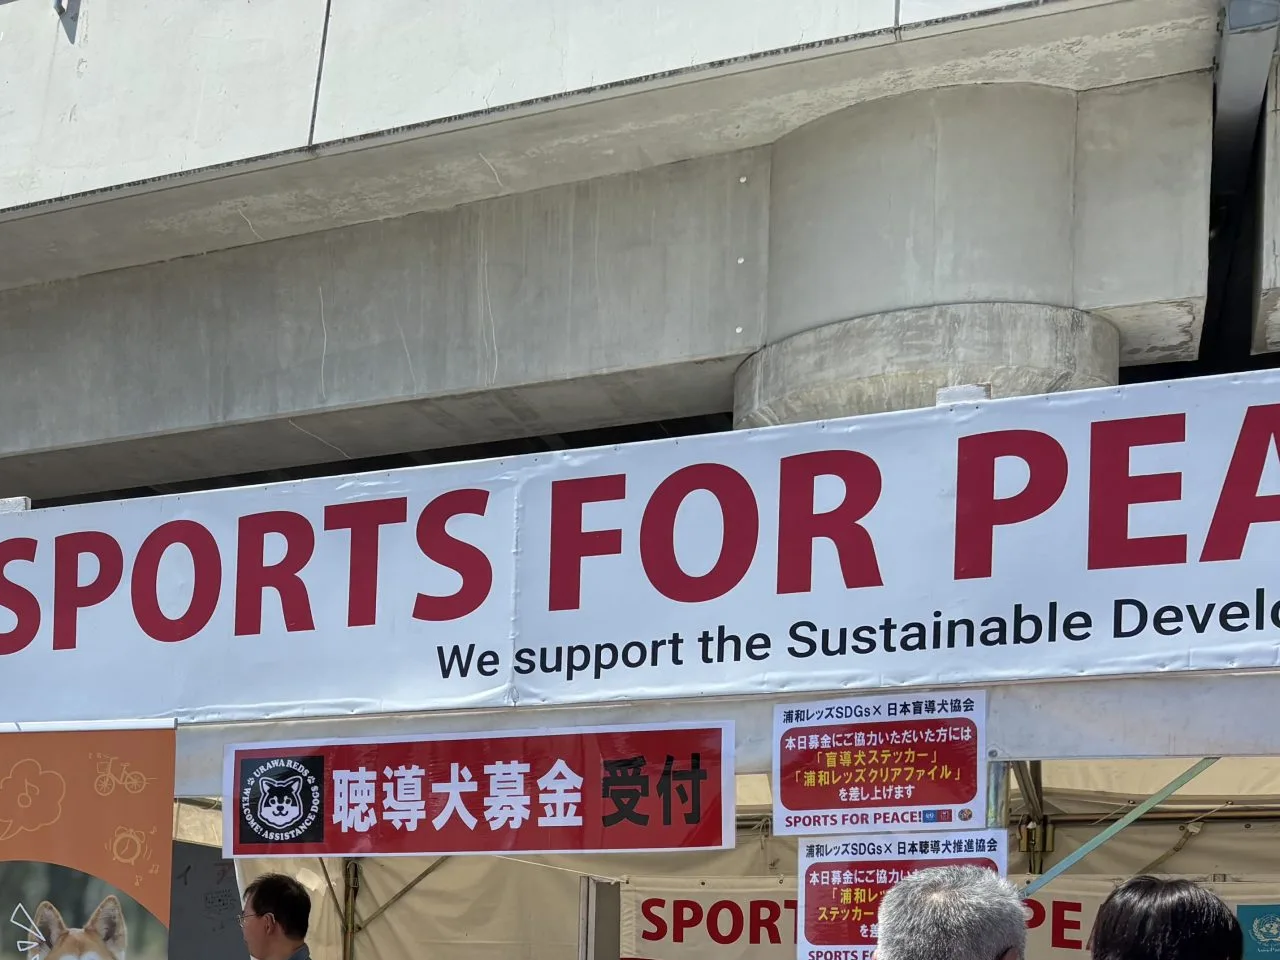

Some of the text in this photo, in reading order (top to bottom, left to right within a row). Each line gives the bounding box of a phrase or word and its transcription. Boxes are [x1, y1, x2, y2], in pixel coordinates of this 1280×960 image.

[549, 449, 884, 611] FOR
[437, 643, 500, 679] We
[514, 632, 684, 680] support
[700, 625, 771, 663] the
[787, 601, 1092, 659] Sustainable
[886, 698, 975, 718] 日本盲導犬協会
[784, 726, 973, 750] 本日募金にご協力いただいた方には
[816, 748, 938, 767] 「盲導犬ステッカー」
[253, 759, 310, 777] URAWA REDS
[794, 765, 962, 787] 「浦和レッズクリアファイル」
[331, 753, 708, 833] 聴導犬募金 受付
[838, 784, 916, 802] を差し上げます
[241, 785, 320, 841] WELCOME! ASSISTANCE DOGS
[785, 810, 922, 828] SPORTS FOR PEACE!
[897, 838, 998, 855] 日本聴導犬推進協会
[809, 868, 920, 886] 本日募金にご協力い
[818, 906, 874, 921] ステッカー
[1022, 898, 1091, 950] PE
